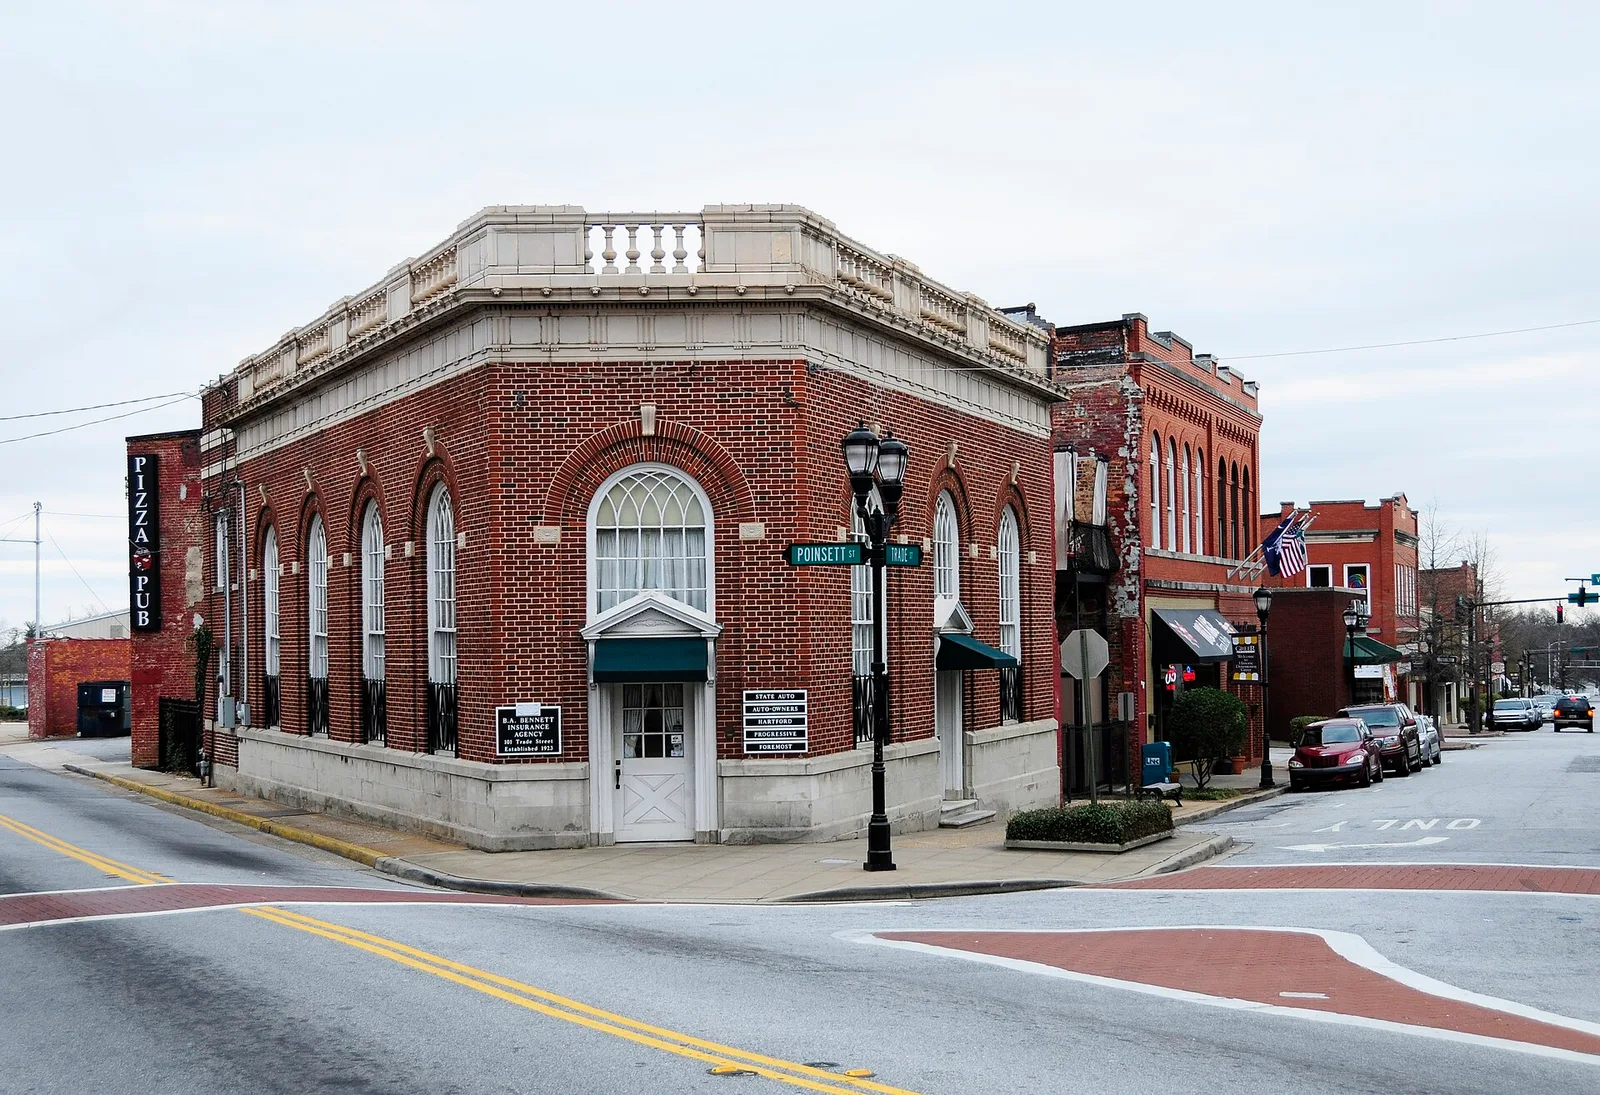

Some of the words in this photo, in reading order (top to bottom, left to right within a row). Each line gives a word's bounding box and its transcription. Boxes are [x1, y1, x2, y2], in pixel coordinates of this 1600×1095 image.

[135, 457, 149, 543] PIZZA
[797, 546, 846, 562] POINSETT
[848, 549, 855, 558] ST
[891, 547, 908, 562] TRADE
[136, 576, 150, 627] PUB
[1312, 818, 1481, 832] ONLY
